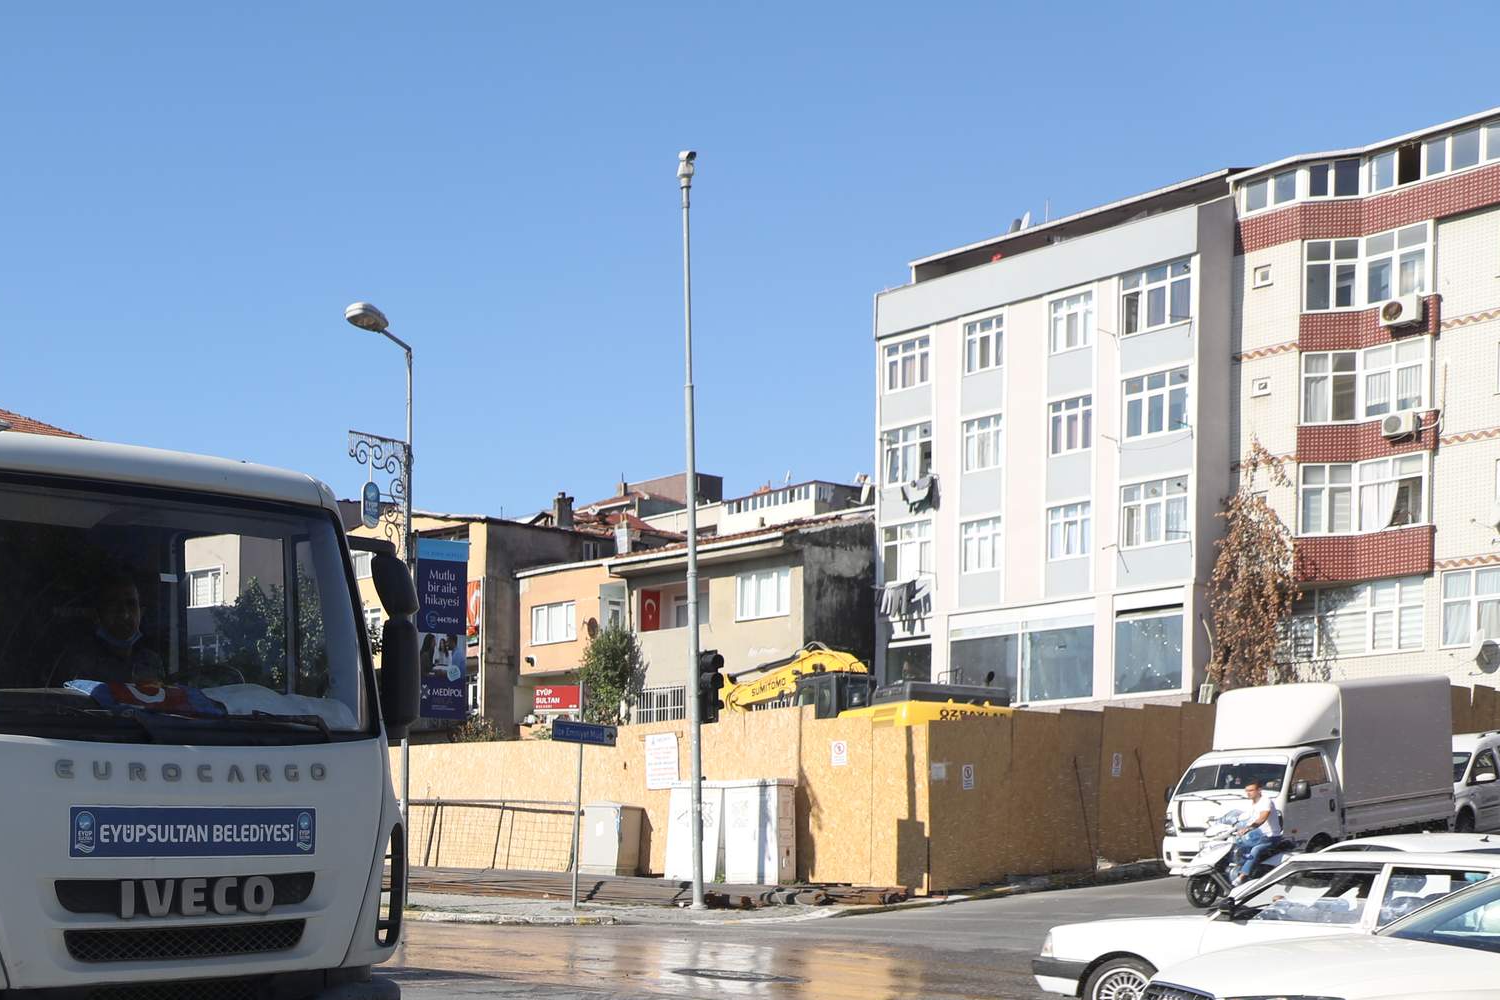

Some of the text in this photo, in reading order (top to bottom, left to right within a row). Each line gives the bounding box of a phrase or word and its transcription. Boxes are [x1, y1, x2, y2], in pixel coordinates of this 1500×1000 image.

[429, 570, 456, 581] Mutlu
[427, 581, 457, 593] bir aile
[425, 594, 460, 608] hikayesi
[55, 759, 327, 783] EUROCARGO
[100, 824, 208, 843] EYÜPSULTAN
[120, 875, 275, 919] IVECO
